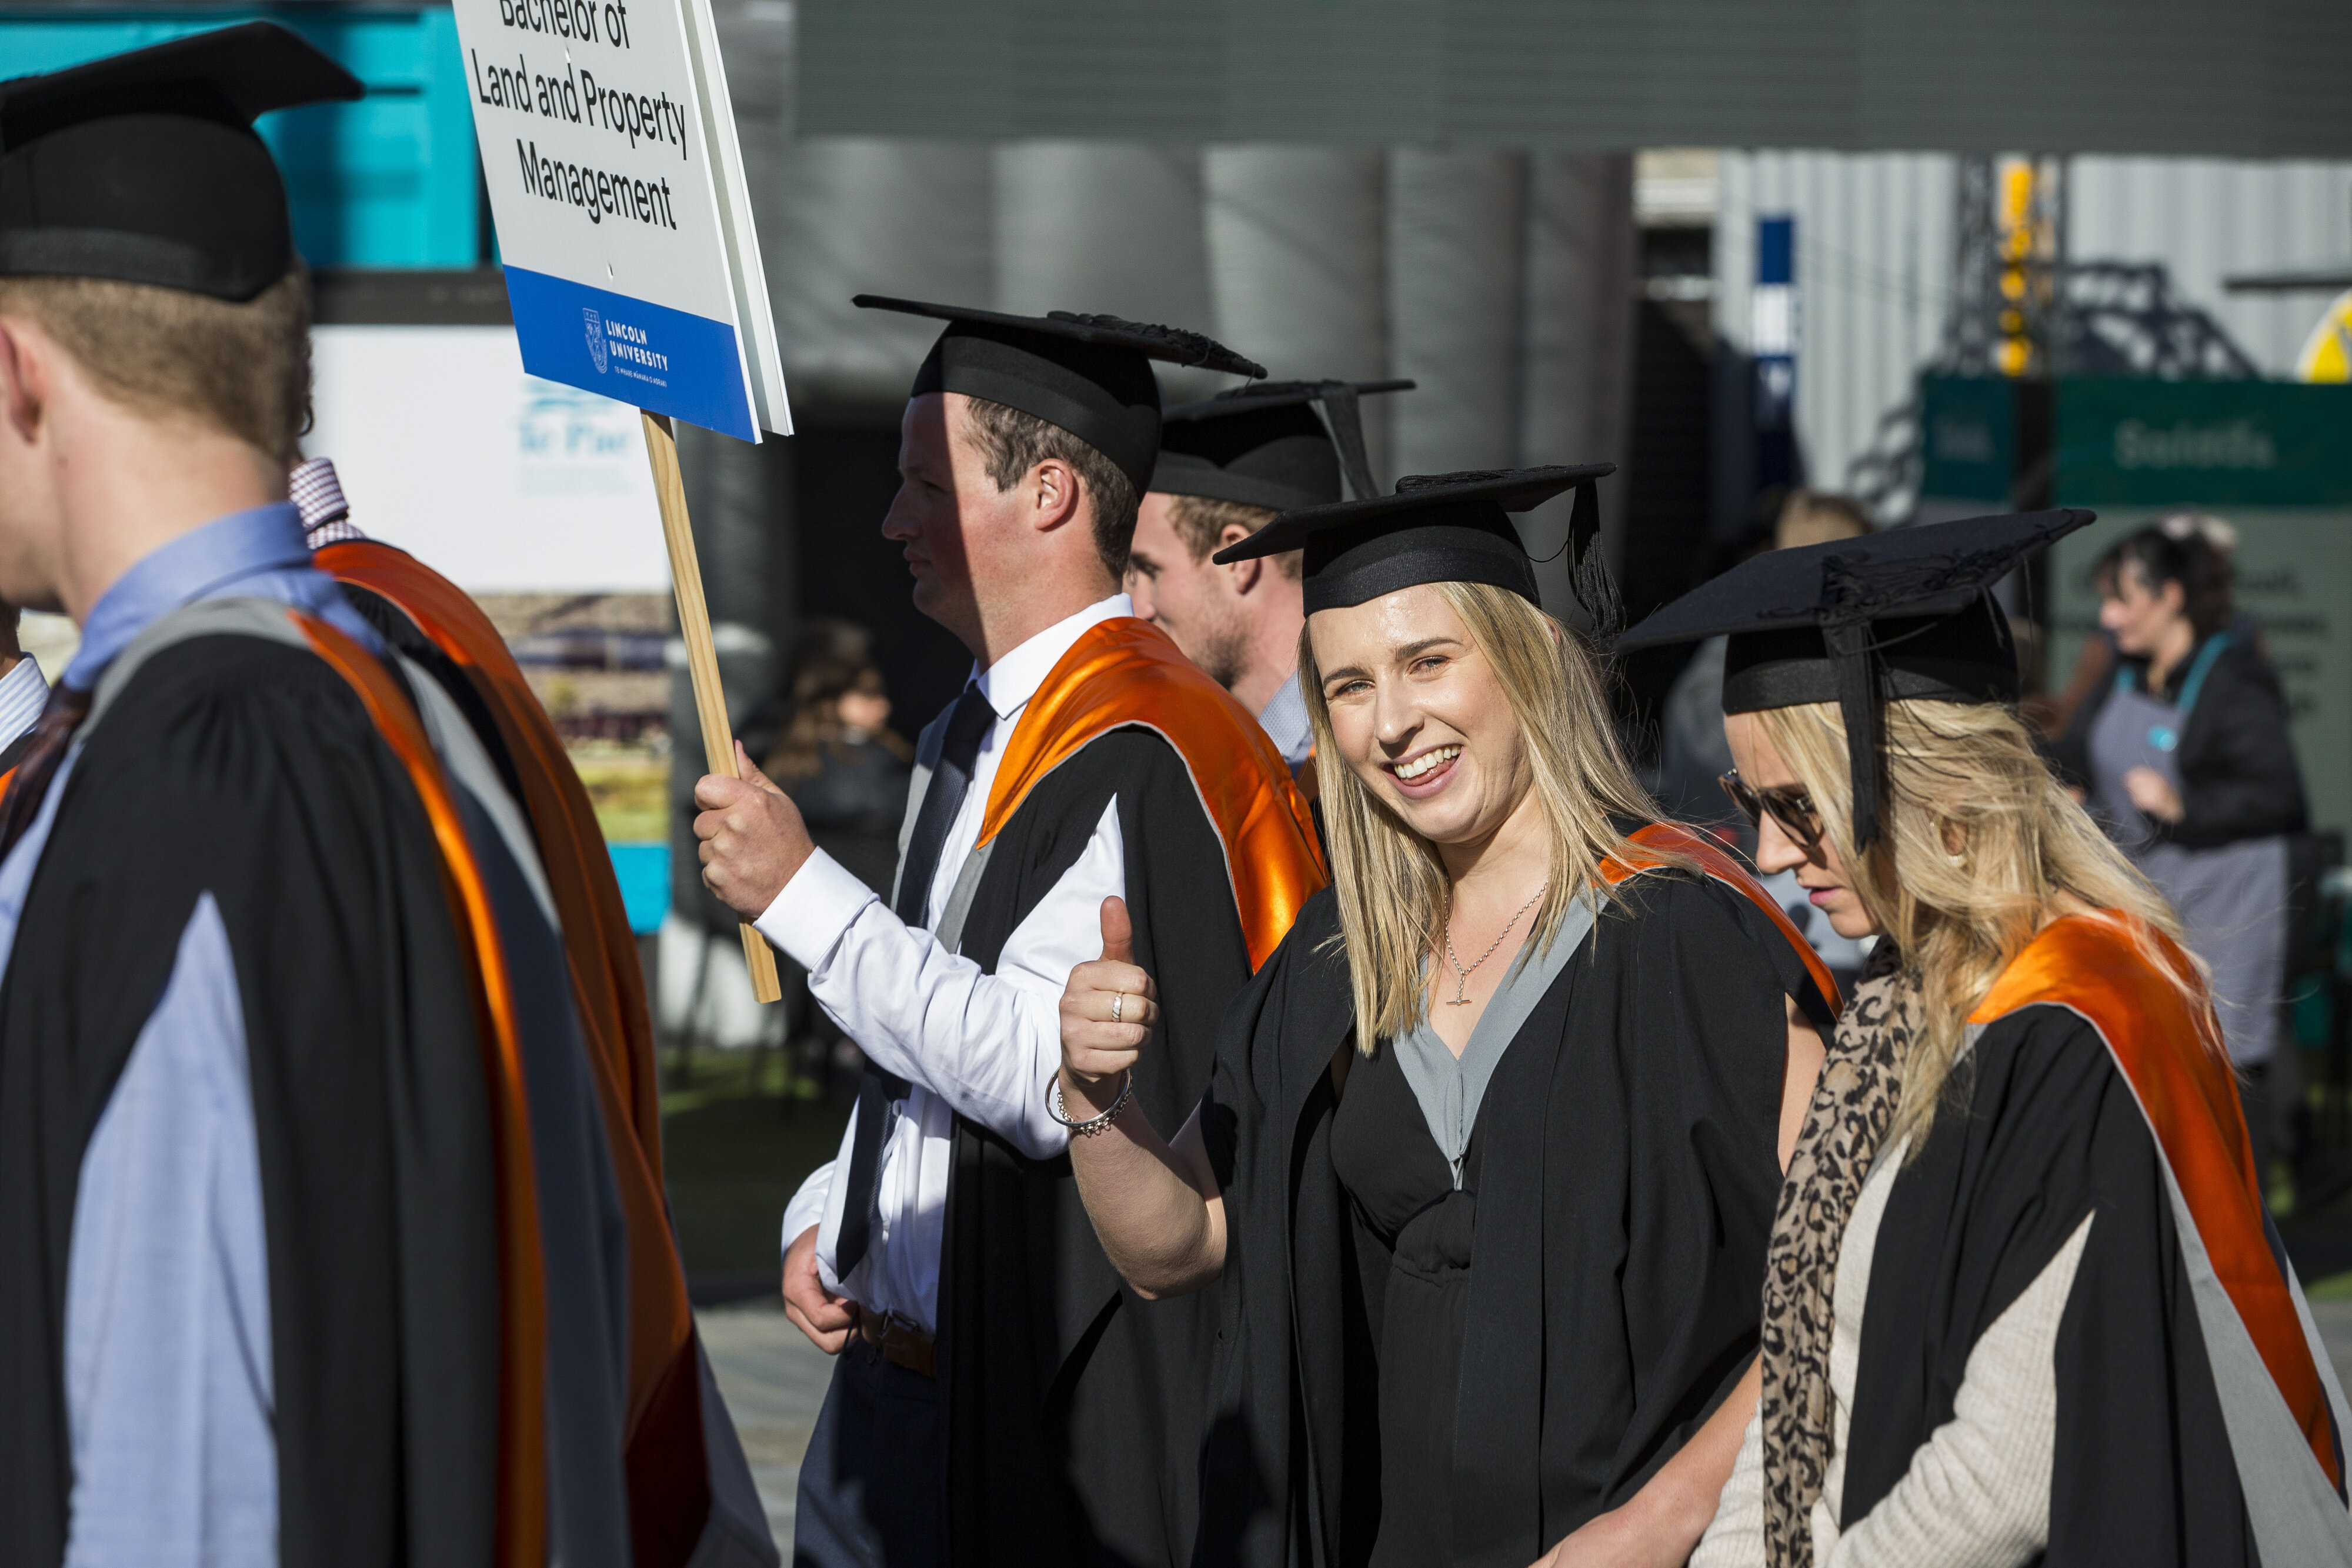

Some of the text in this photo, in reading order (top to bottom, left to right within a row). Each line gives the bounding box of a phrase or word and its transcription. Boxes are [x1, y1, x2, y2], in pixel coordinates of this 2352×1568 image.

[605, 0, 630, 49] of
[472, 49, 686, 161] Land and Property
[516, 138, 676, 230] Management
[606, 319, 648, 345] LINCOLN
[609, 340, 668, 371] UNIVERSITY
